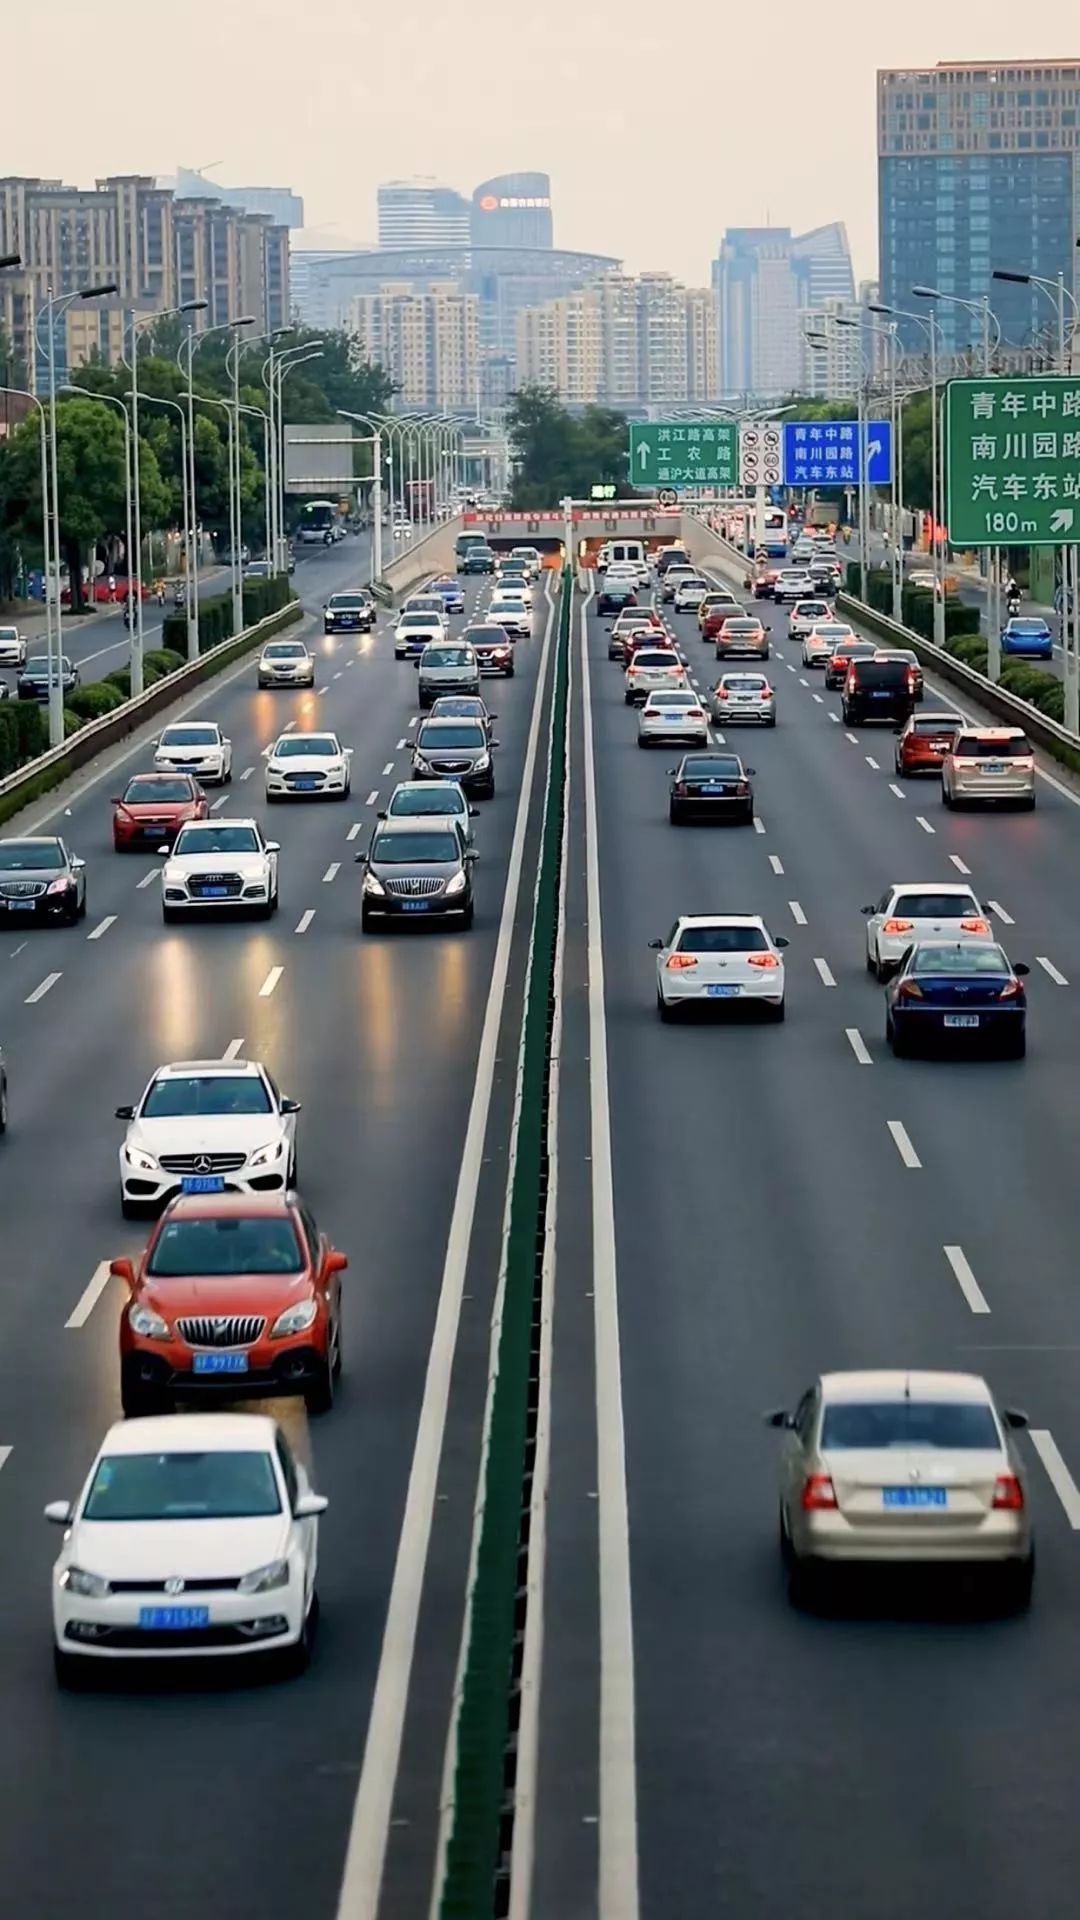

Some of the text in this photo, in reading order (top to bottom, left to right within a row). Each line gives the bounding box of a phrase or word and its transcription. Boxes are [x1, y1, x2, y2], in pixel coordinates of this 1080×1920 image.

[970, 390, 1080, 420] 青年中路
[657, 428, 731, 441] 洪江路高架
[794, 427, 853, 441] 青年中路
[970, 431, 1080, 461] 南川园路
[794, 447, 853, 460] 南川园路
[657, 467, 731, 480] 通沪大道高架
[794, 466, 854, 479] 汽车东站
[971, 473, 1080, 501] 汽车东站
[985, 512, 1037, 532] 180m
